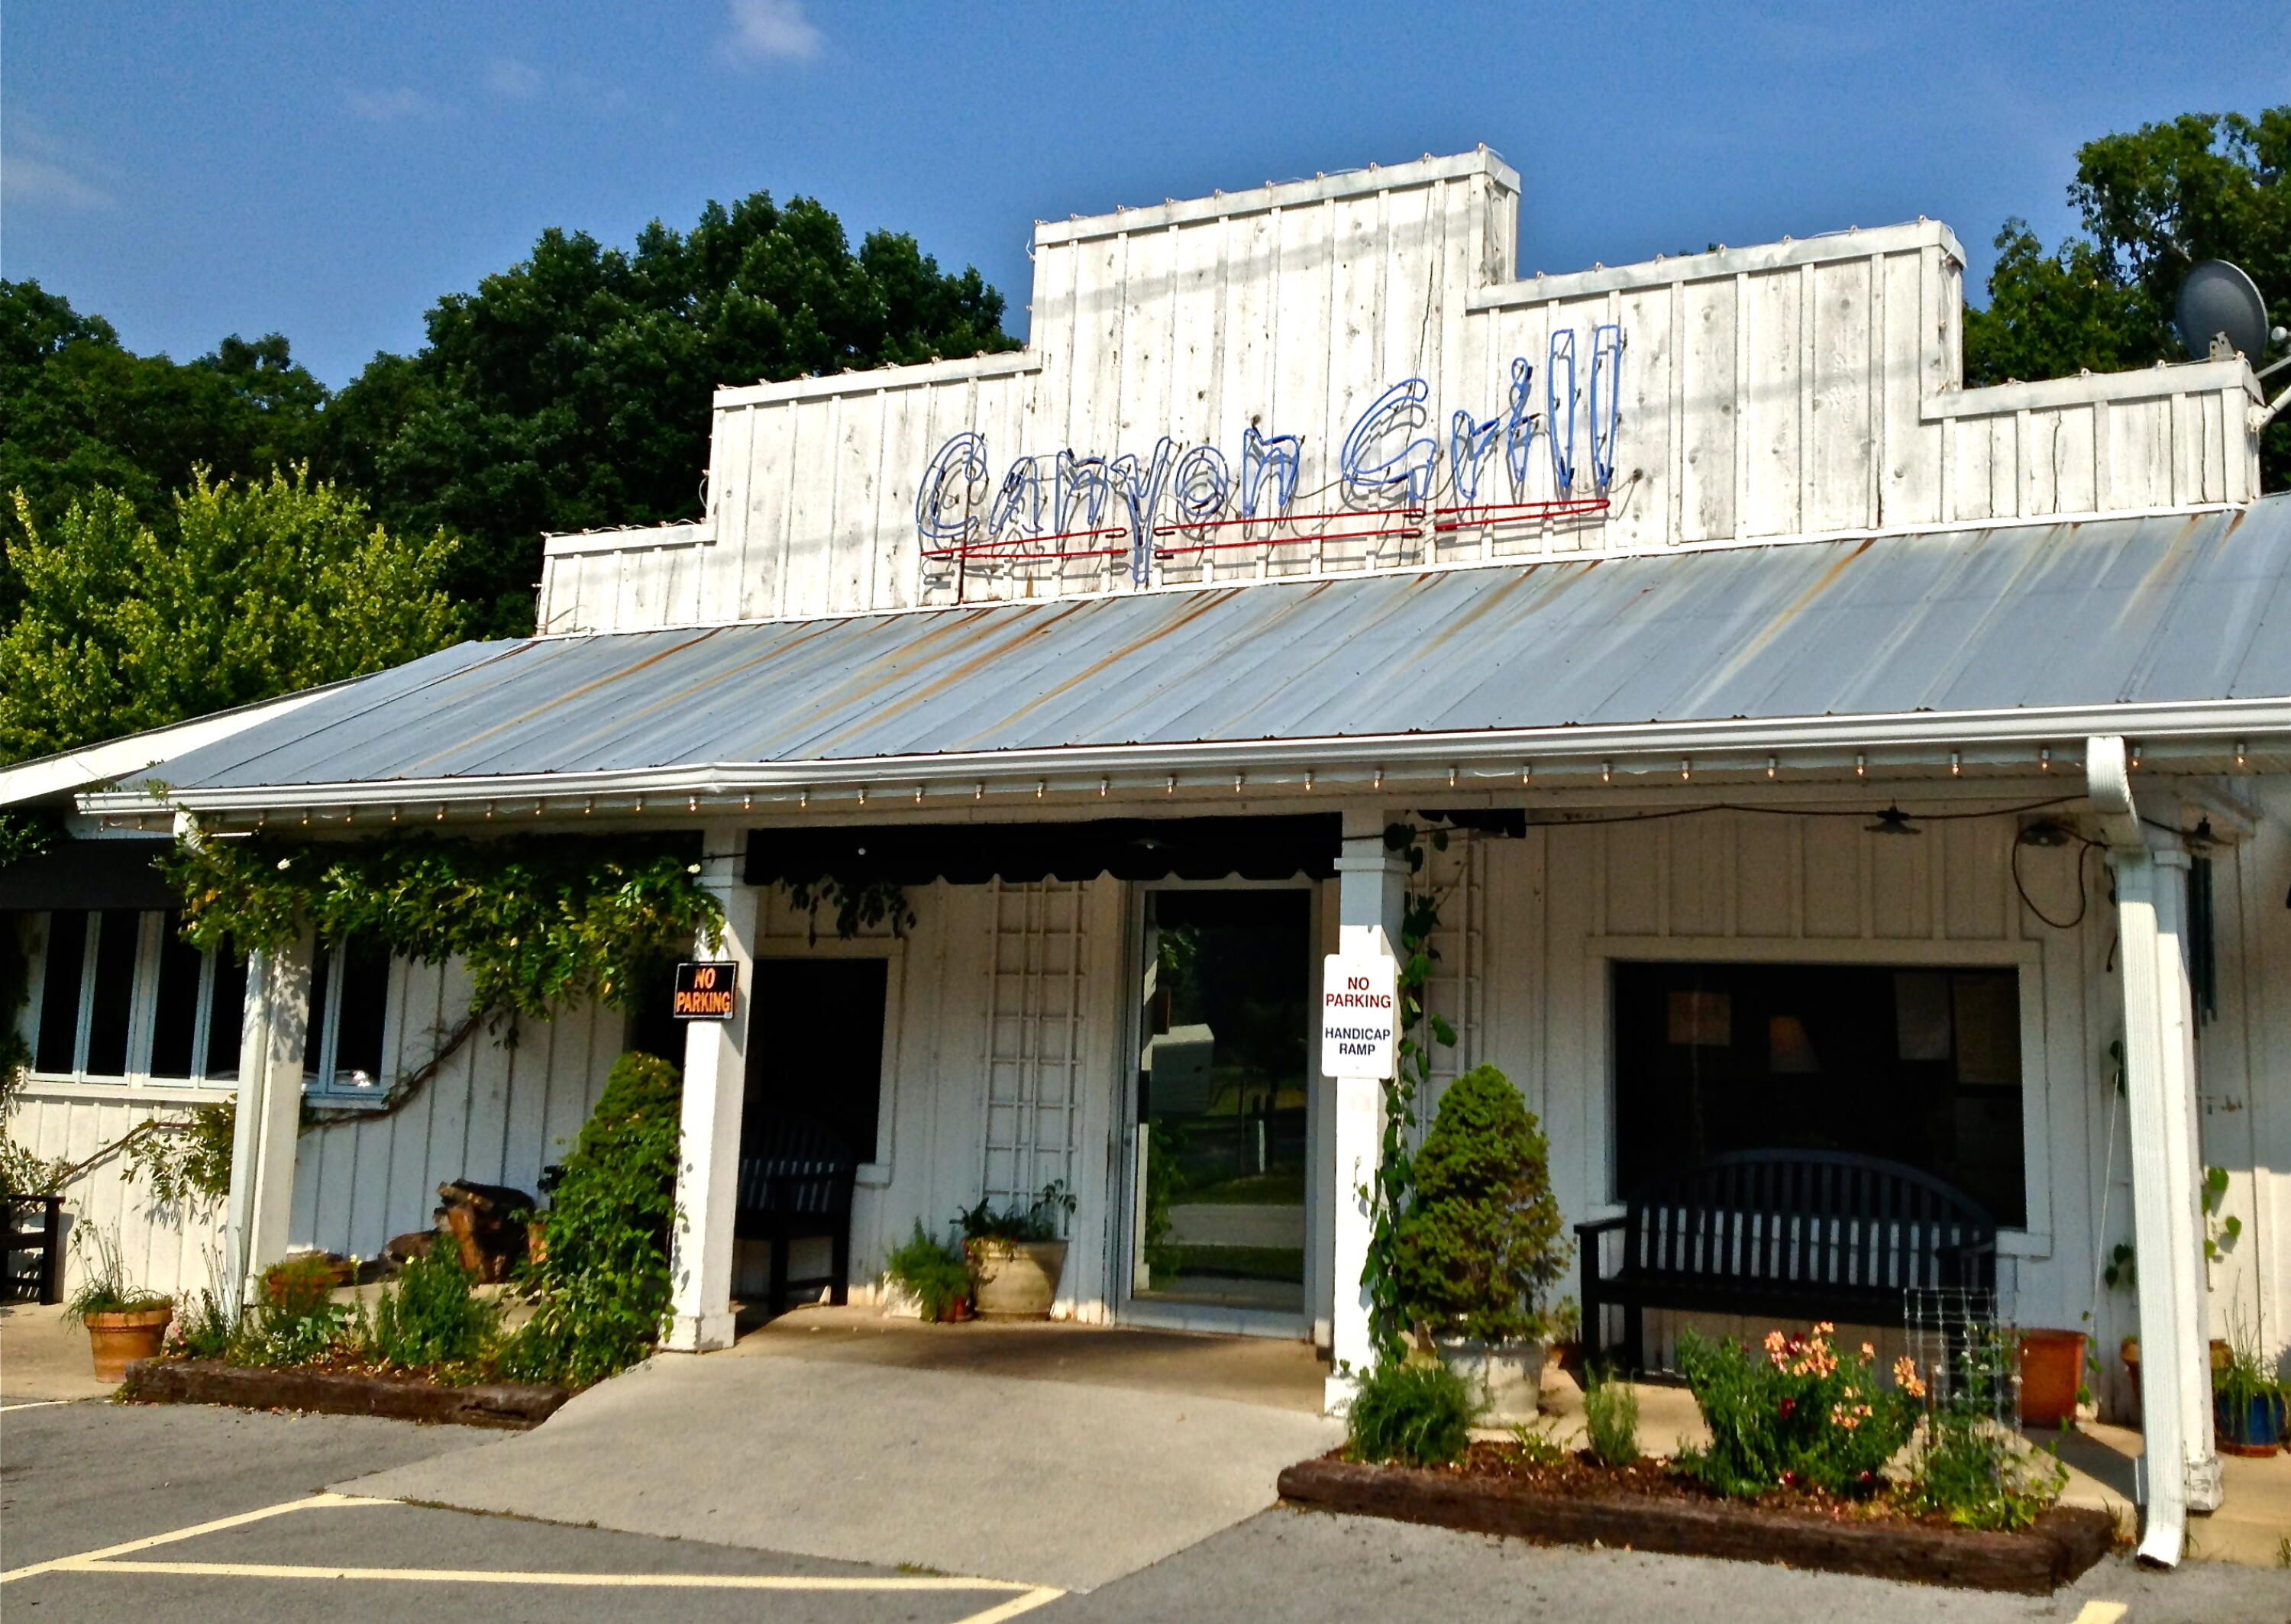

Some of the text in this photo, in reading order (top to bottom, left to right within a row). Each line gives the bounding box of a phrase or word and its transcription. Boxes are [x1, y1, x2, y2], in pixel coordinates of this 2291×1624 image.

[917, 324, 1621, 583] Canyon Grill
[694, 967, 716, 989] NO
[1348, 977, 1369, 990] NO
[676, 991, 731, 1012] PARKING
[1326, 993, 1391, 1008] PARKING
[1325, 1027, 1391, 1041] HANDICAP
[1339, 1043, 1375, 1055] RAMP
